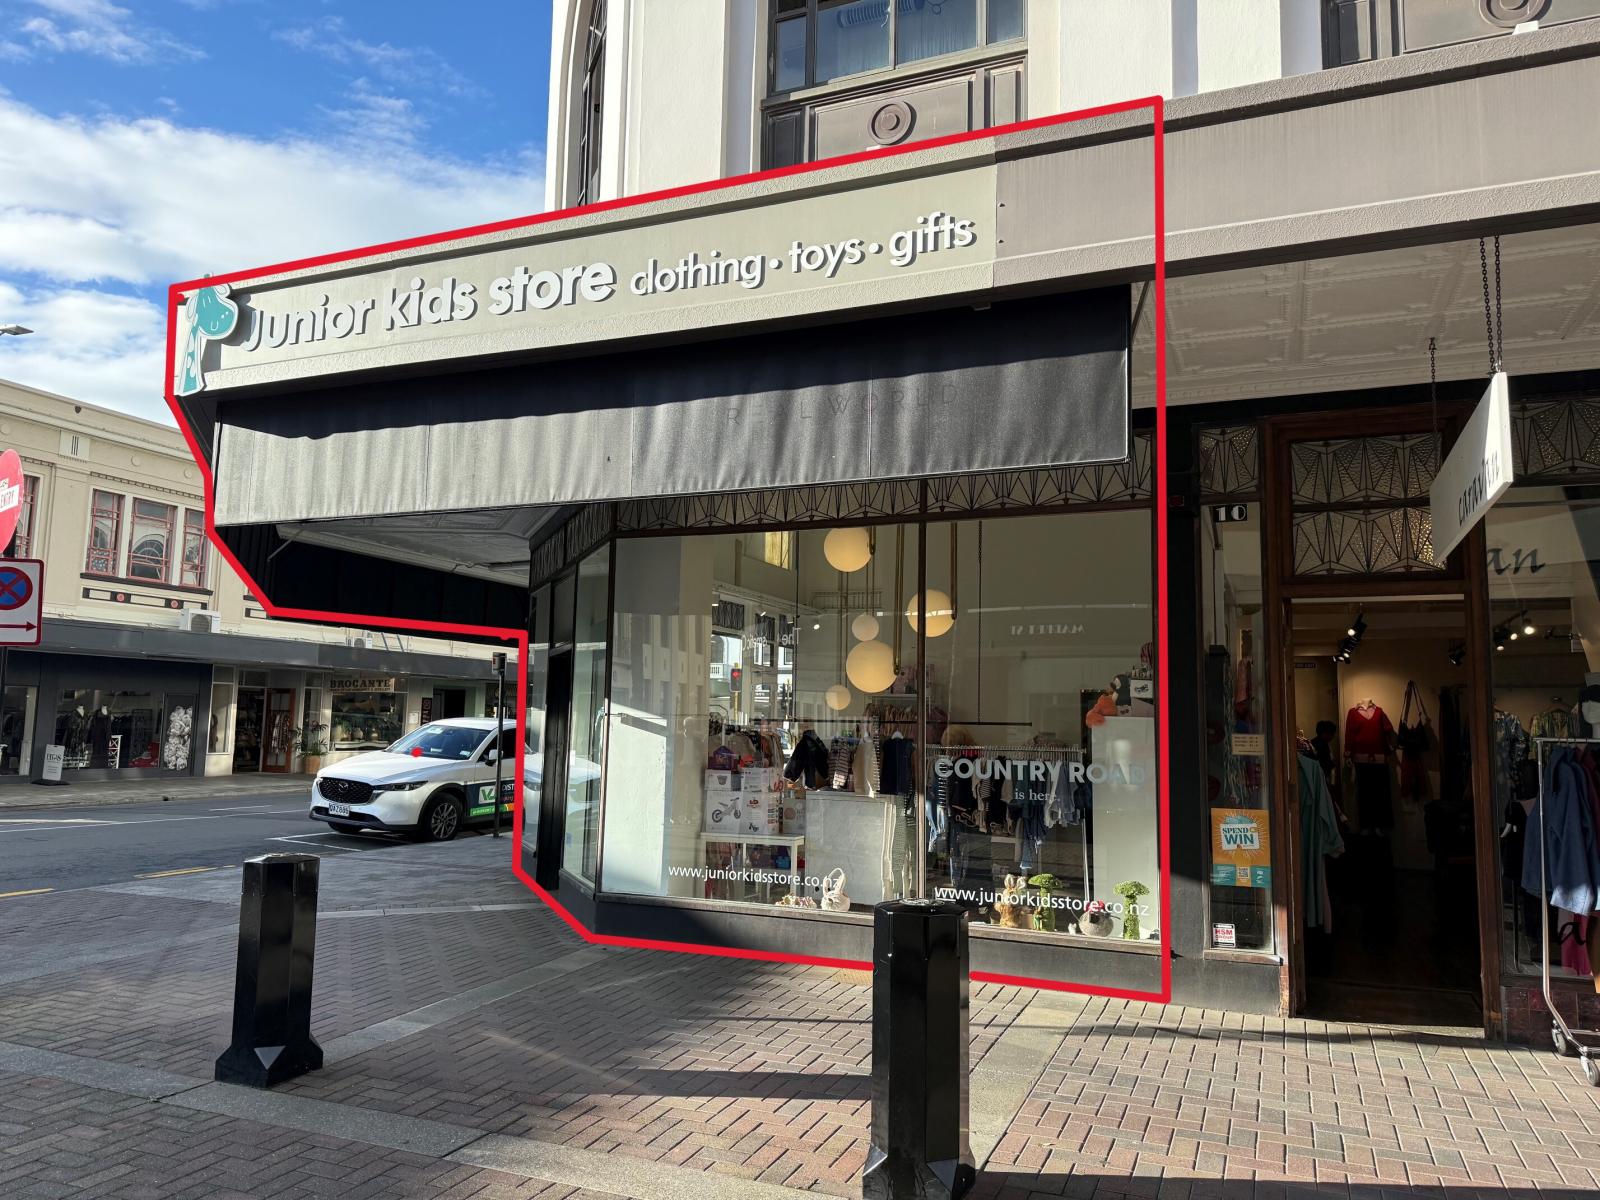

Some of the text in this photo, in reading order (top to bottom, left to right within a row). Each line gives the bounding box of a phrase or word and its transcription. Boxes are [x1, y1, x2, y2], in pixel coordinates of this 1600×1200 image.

[630, 211, 976, 290] clothing toys gifts
[242, 262, 616, 352] Junior kids store
[1215, 505, 1246, 521] 10
[330, 678, 391, 689] BROCANTE
[934, 757, 1147, 785] COUNTRY ROAD
[1015, 788, 1025, 800] is
[1222, 827, 1249, 835] SPEND
[1224, 834, 1255, 845] WIN
